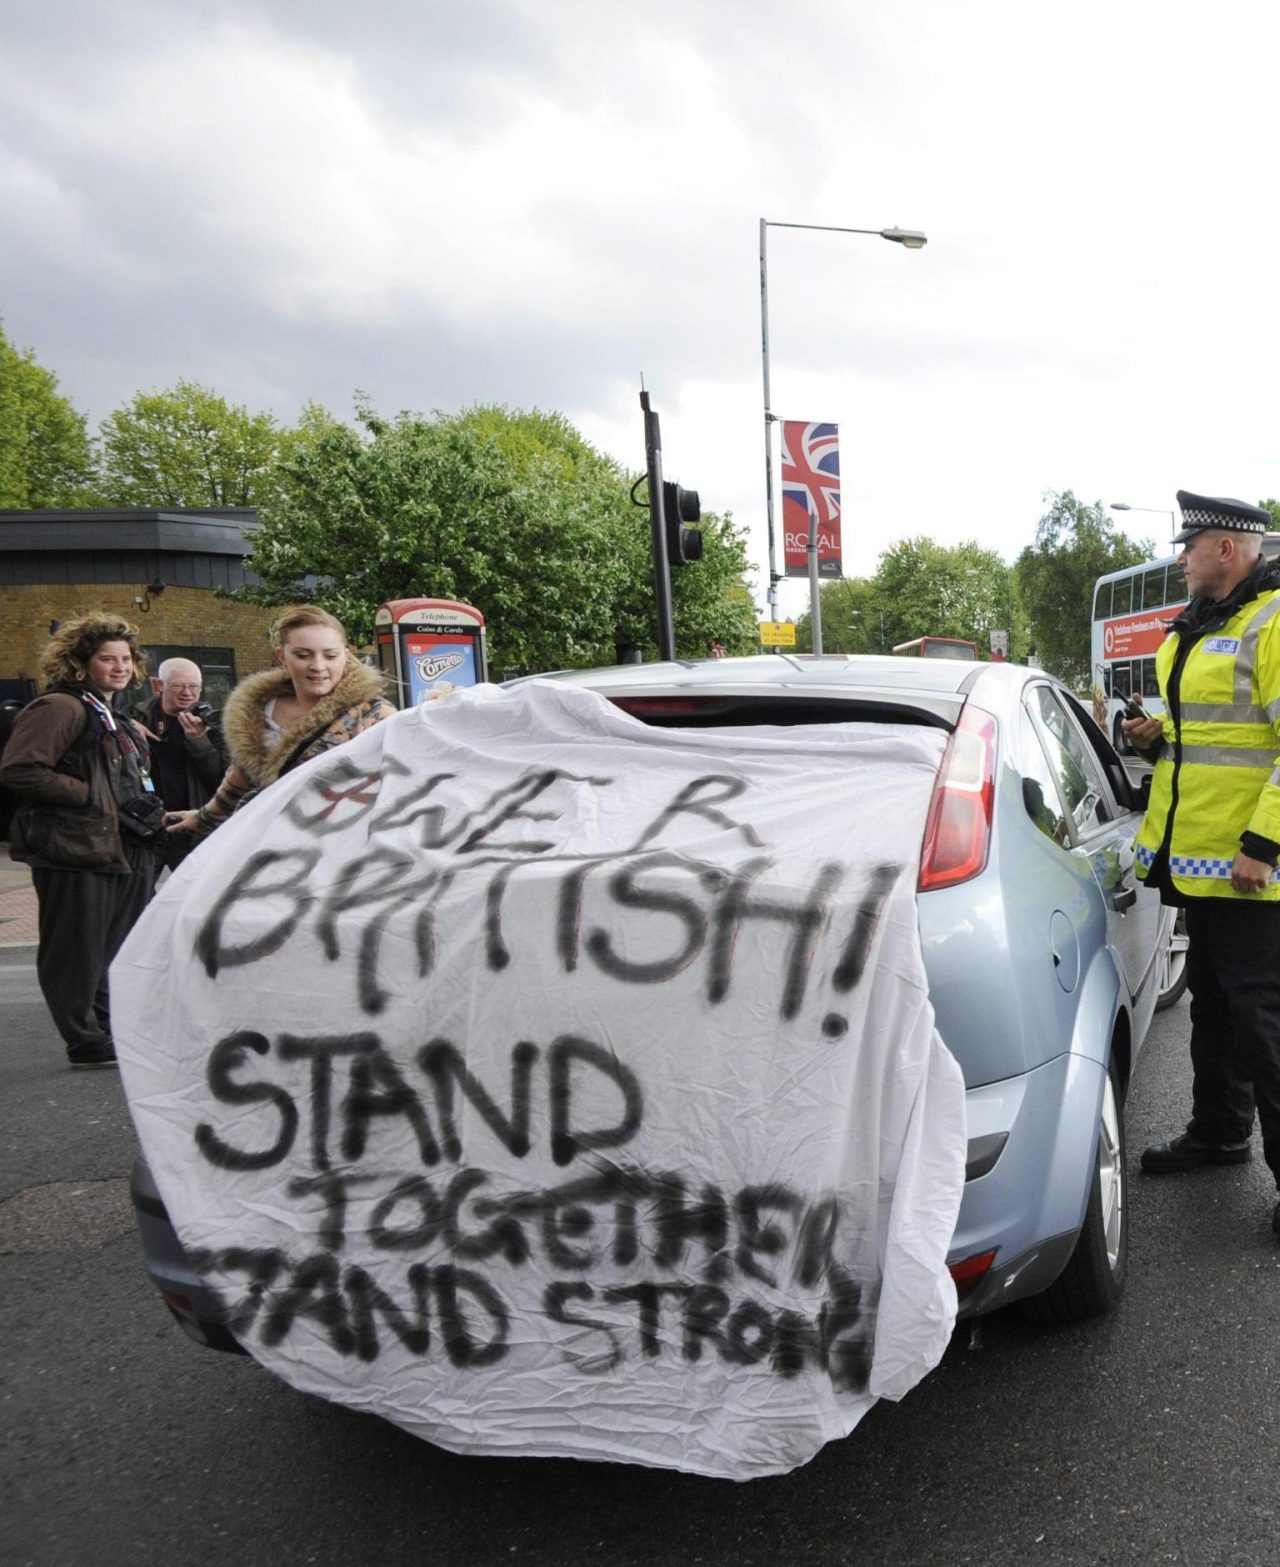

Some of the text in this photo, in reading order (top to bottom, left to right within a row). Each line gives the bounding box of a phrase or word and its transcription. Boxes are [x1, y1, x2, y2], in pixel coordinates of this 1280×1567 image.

[785, 532, 840, 549] ROAL
[420, 612, 458, 621] Telephone
[416, 625, 435, 633] Coins
[415, 653, 463, 682] Cornetto
[195, 848, 902, 1040] BRITISH!
[196, 1030, 644, 1172] STAND
